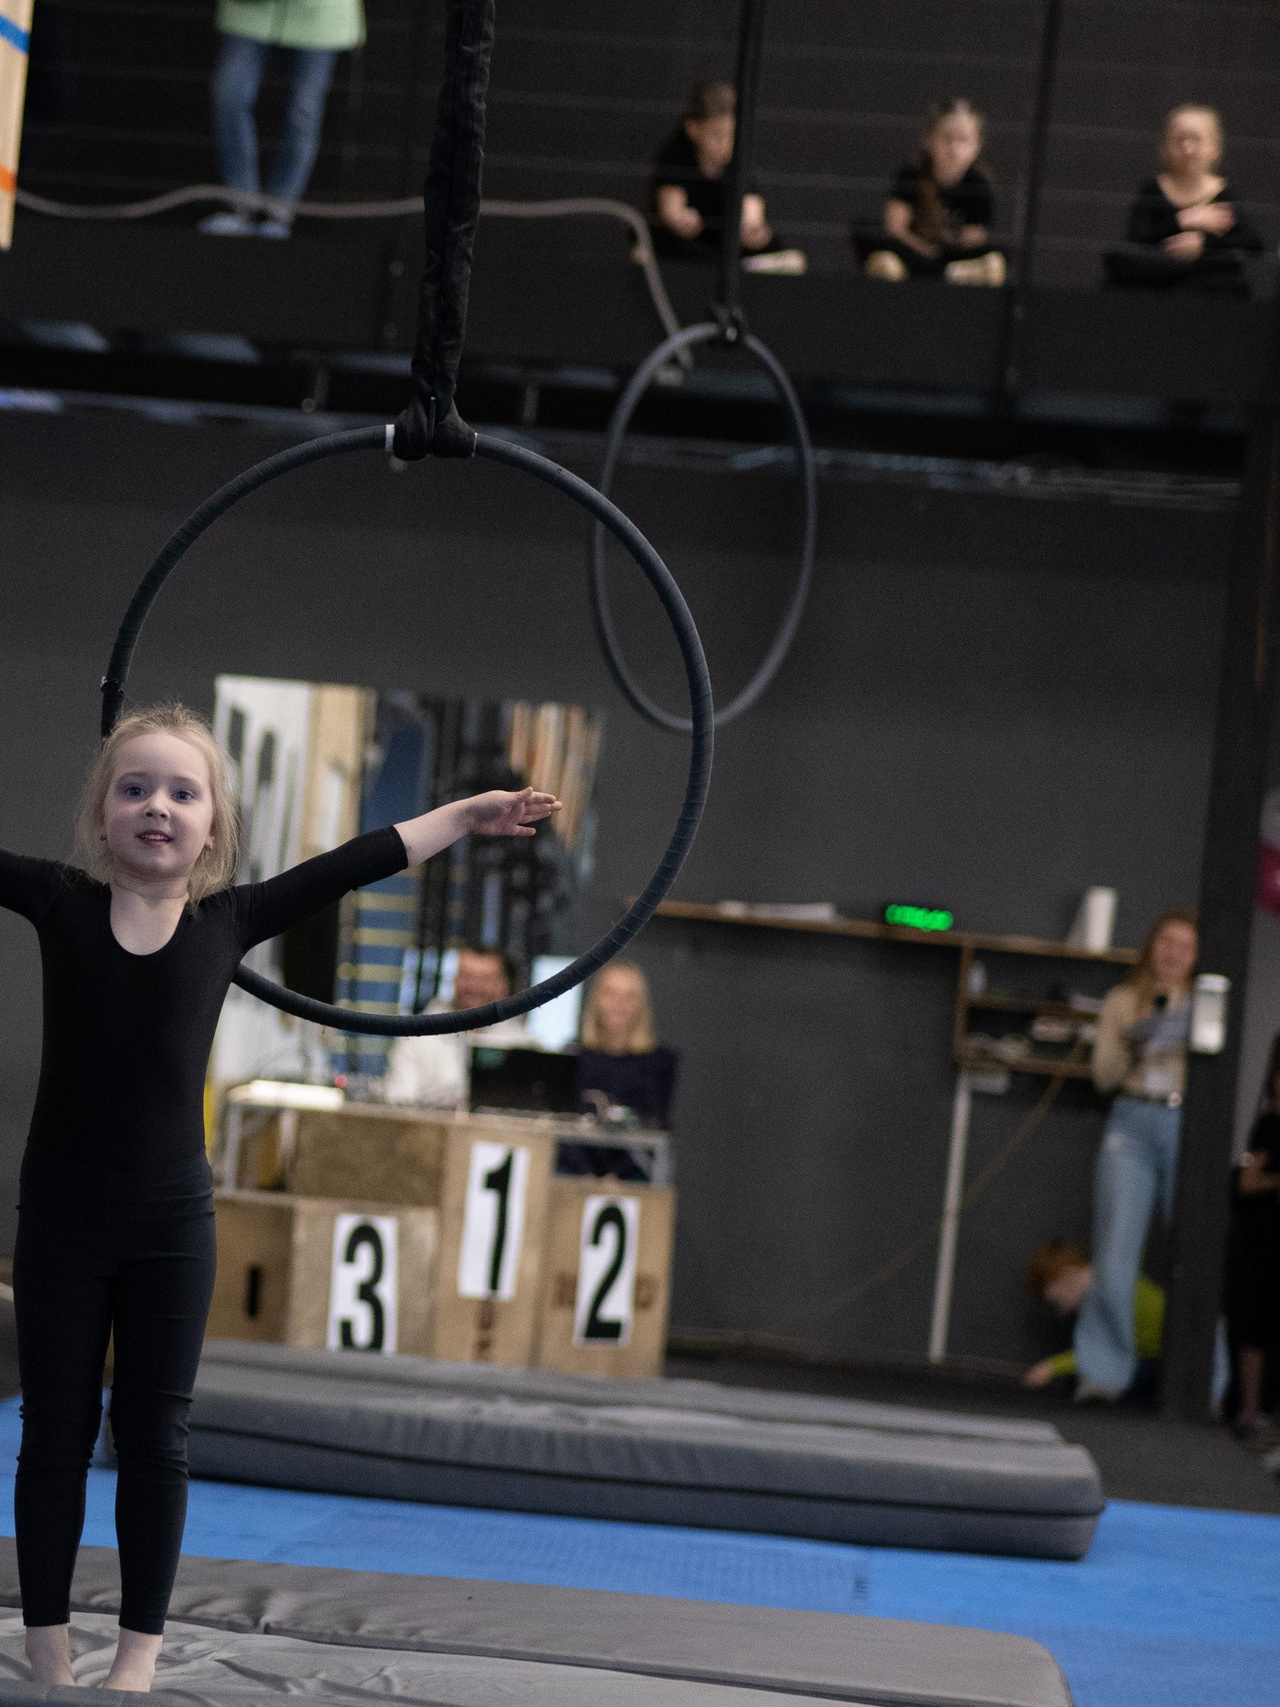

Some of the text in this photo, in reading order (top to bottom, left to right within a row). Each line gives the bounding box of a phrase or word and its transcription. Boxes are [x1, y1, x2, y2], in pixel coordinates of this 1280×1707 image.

[340, 1222, 386, 1352] 3
[483, 1148, 514, 1292] 1
[583, 1204, 627, 1340] 2
